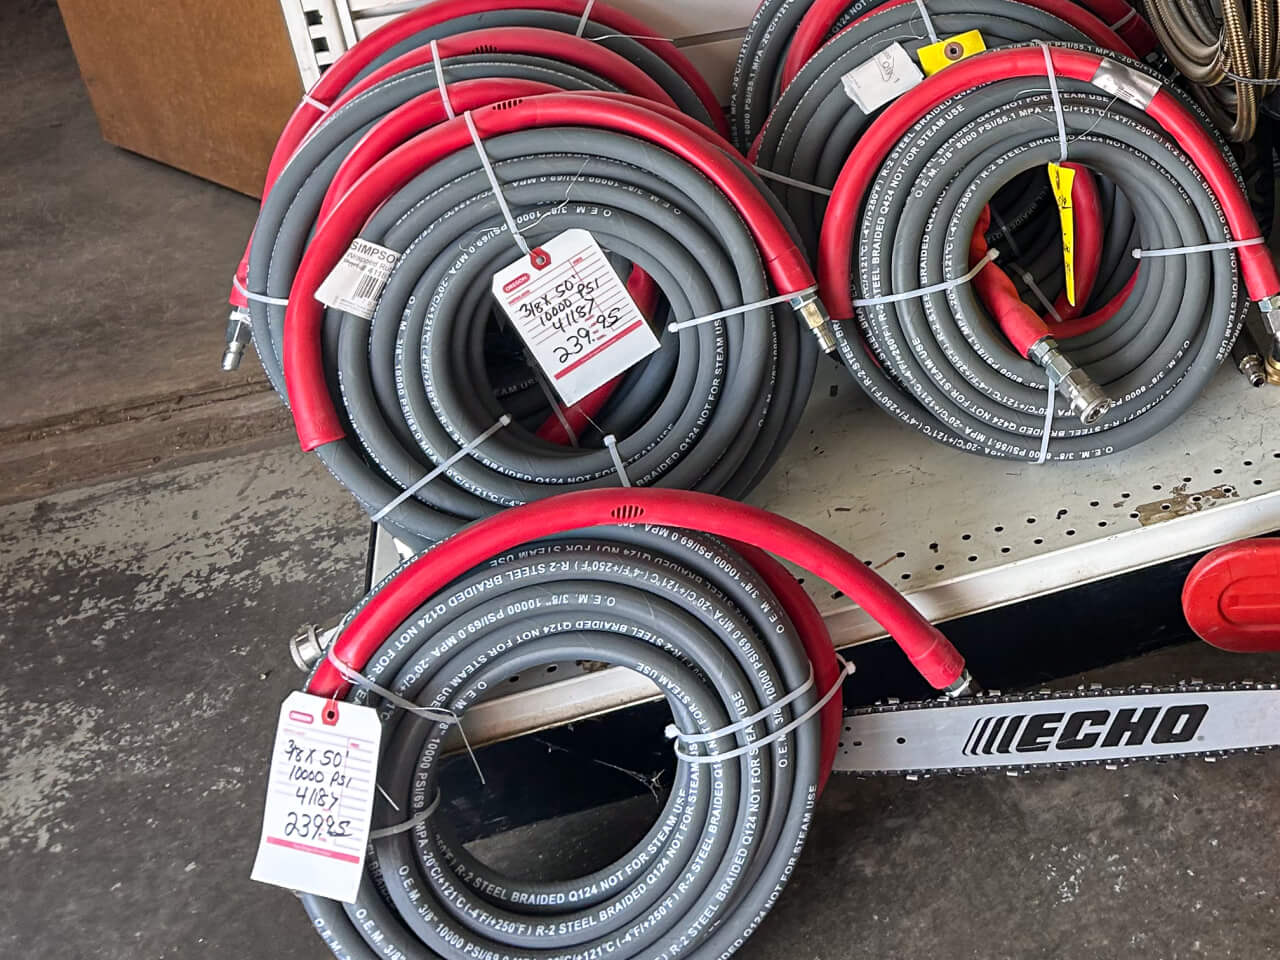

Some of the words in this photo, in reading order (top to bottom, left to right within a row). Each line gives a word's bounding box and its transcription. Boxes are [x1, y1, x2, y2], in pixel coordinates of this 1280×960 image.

[1019, 107, 1042, 117] MPA
[872, 216, 886, 265] BRAIDED
[880, 192, 894, 214] Q424
[891, 167, 905, 188] NOT
[903, 148, 920, 168] FOR
[919, 118, 946, 150] STEAM
[946, 103, 966, 123] USE
[539, 299, 573, 326] 10000
[714, 339, 725, 375] STEAM
[709, 378, 721, 401] FOR
[696, 405, 711, 425] NOT
[679, 427, 700, 451] Q124
[636, 451, 680, 486] BRAIDED
[505, 562, 545, 581] STEEL
[448, 575, 503, 607] BRAIDED
[417, 604, 447, 629] Q124
[394, 628, 419, 650] NOT
[372, 653, 396, 676] FOR
[1016, 703, 1209, 753] ECHO
[289, 765, 324, 783] 10000
[474, 875, 511, 899] STEEL
[511, 892, 565, 905] BRAIDED
[568, 887, 598, 902] Q124
[600, 872, 625, 893] NOT
[627, 852, 649, 876] FOR
[648, 814, 678, 857] STEAM
[674, 789, 687, 815] USE
